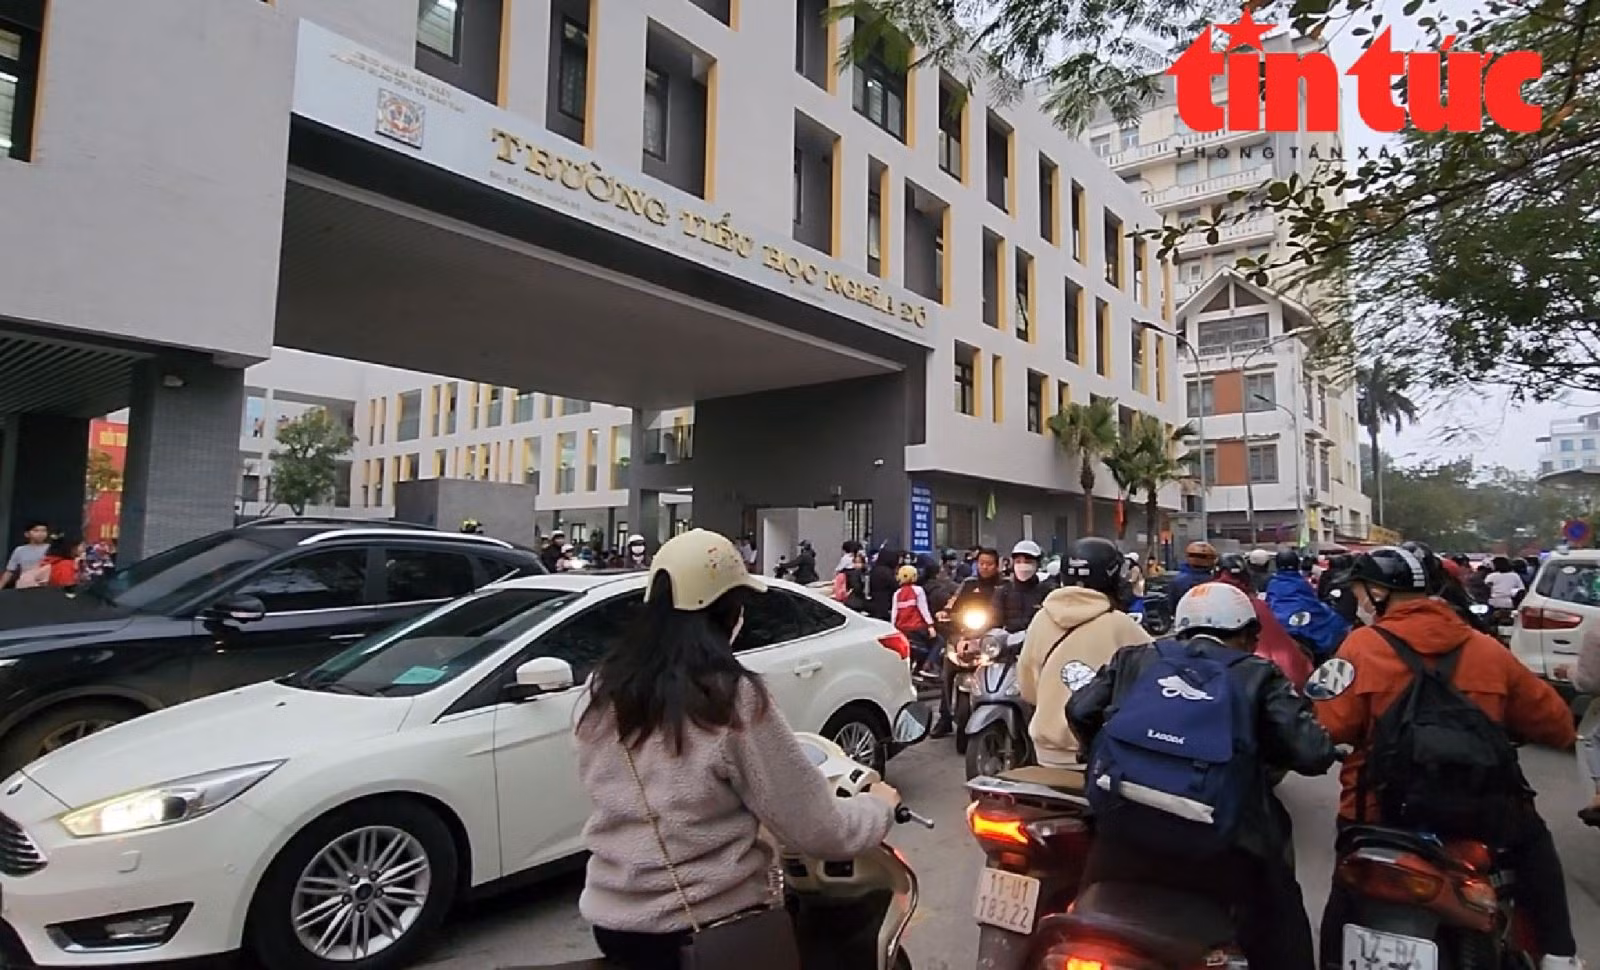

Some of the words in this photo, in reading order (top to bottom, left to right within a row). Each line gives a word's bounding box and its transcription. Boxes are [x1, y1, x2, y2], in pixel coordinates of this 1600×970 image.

[491, 128, 671, 227] TRƯỜNG
[679, 212, 754, 259] TIỂU
[762, 244, 819, 285] HỌC
[823, 269, 896, 316] NGHĨA
